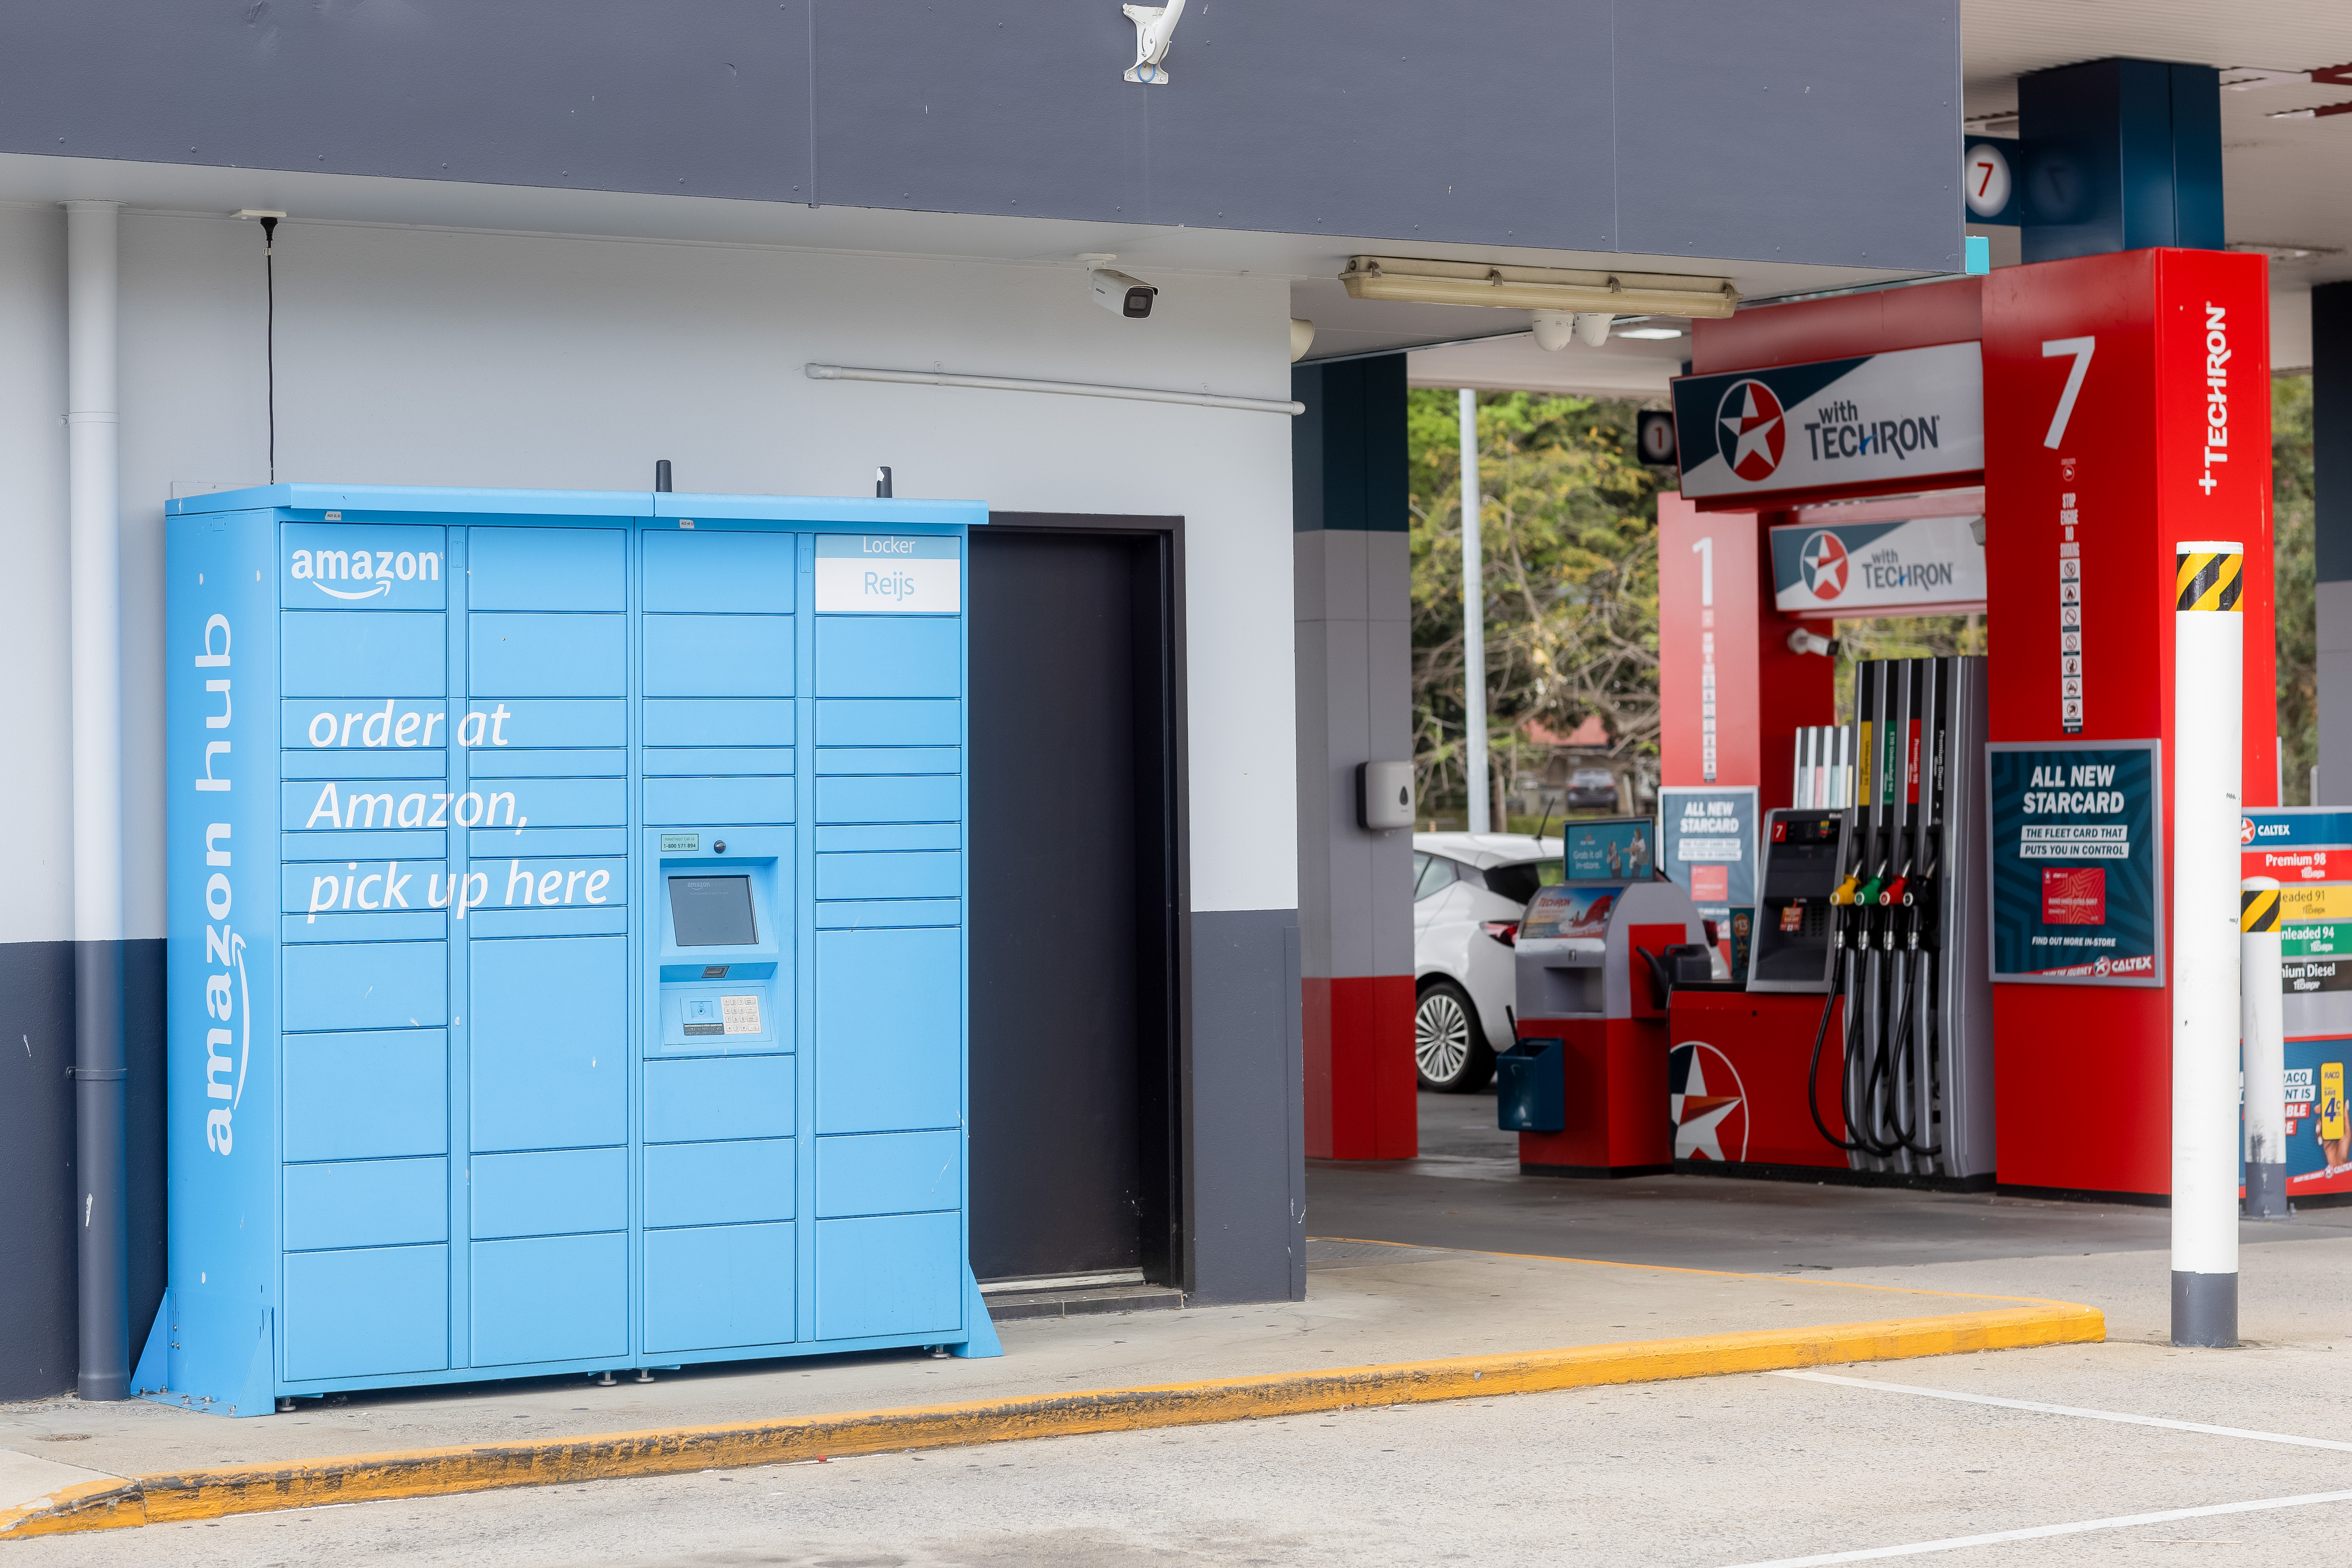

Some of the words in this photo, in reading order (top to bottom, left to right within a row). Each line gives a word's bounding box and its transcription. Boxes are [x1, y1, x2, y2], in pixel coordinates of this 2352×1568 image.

[1977, 161, 1994, 198] 7
[2041, 335, 2095, 450] 7
[1818, 399, 1858, 424] with
[1655, 426, 1663, 448] 1
[1804, 414, 1939, 461] TECHRON
[862, 536, 915, 554] Locker
[291, 549, 440, 581] amazon
[1871, 548, 1898, 564] with
[1692, 536, 1713, 607] 1
[1861, 561, 1953, 591] TECHRON
[864, 571, 915, 602] Reijs
[195, 613, 232, 792] hub
[308, 699, 444, 748] order
[457, 703, 511, 747] at
[2030, 765, 2065, 788] ALL
[2070, 764, 2116, 787] NEW
[305, 782, 529, 836] Amazon,
[1684, 801, 1706, 817] ALL
[1706, 800, 1735, 817] NEW
[2022, 791, 2125, 815] STARCARD
[1679, 817, 1740, 834] STARCARD
[1776, 824, 1784, 839] 7
[2026, 828, 2043, 838] THE
[2045, 828, 2071, 838] FLEET
[2073, 828, 2098, 838] CARD
[2101, 828, 2123, 838] THAT
[2257, 824, 2290, 836] CALTEX
[1573, 850, 1589, 860] Grab
[1589, 850, 1595, 859] it
[1595, 849, 1603, 859] all
[2025, 845, 2048, 855] PUTS
[2049, 845, 2068, 855] YOU
[2070, 845, 2080, 855] IN
[2082, 845, 2124, 855] CONTROL
[2266, 853, 2312, 866] Premium
[2313, 852, 2327, 866] 98
[306, 861, 414, 924] pick
[427, 870, 489, 920] up
[504, 859, 611, 906] here
[2315, 889, 2325, 902] 91
[2031, 936, 2048, 945] FIND
[2049, 936, 2063, 946] OUT
[2063, 937, 2083, 947] MORE
[2084, 937, 2116, 947] IN-STORE
[2281, 926, 2321, 940] nleaded
[2322, 926, 2335, 940] 94
[2112, 955, 2152, 973] CALTEX
[2306, 962, 2336, 978] Diesel
[206, 823, 233, 1156] amazon
[2283, 1072, 2308, 1085] ACQ
[2301, 1088, 2311, 1099] IS
